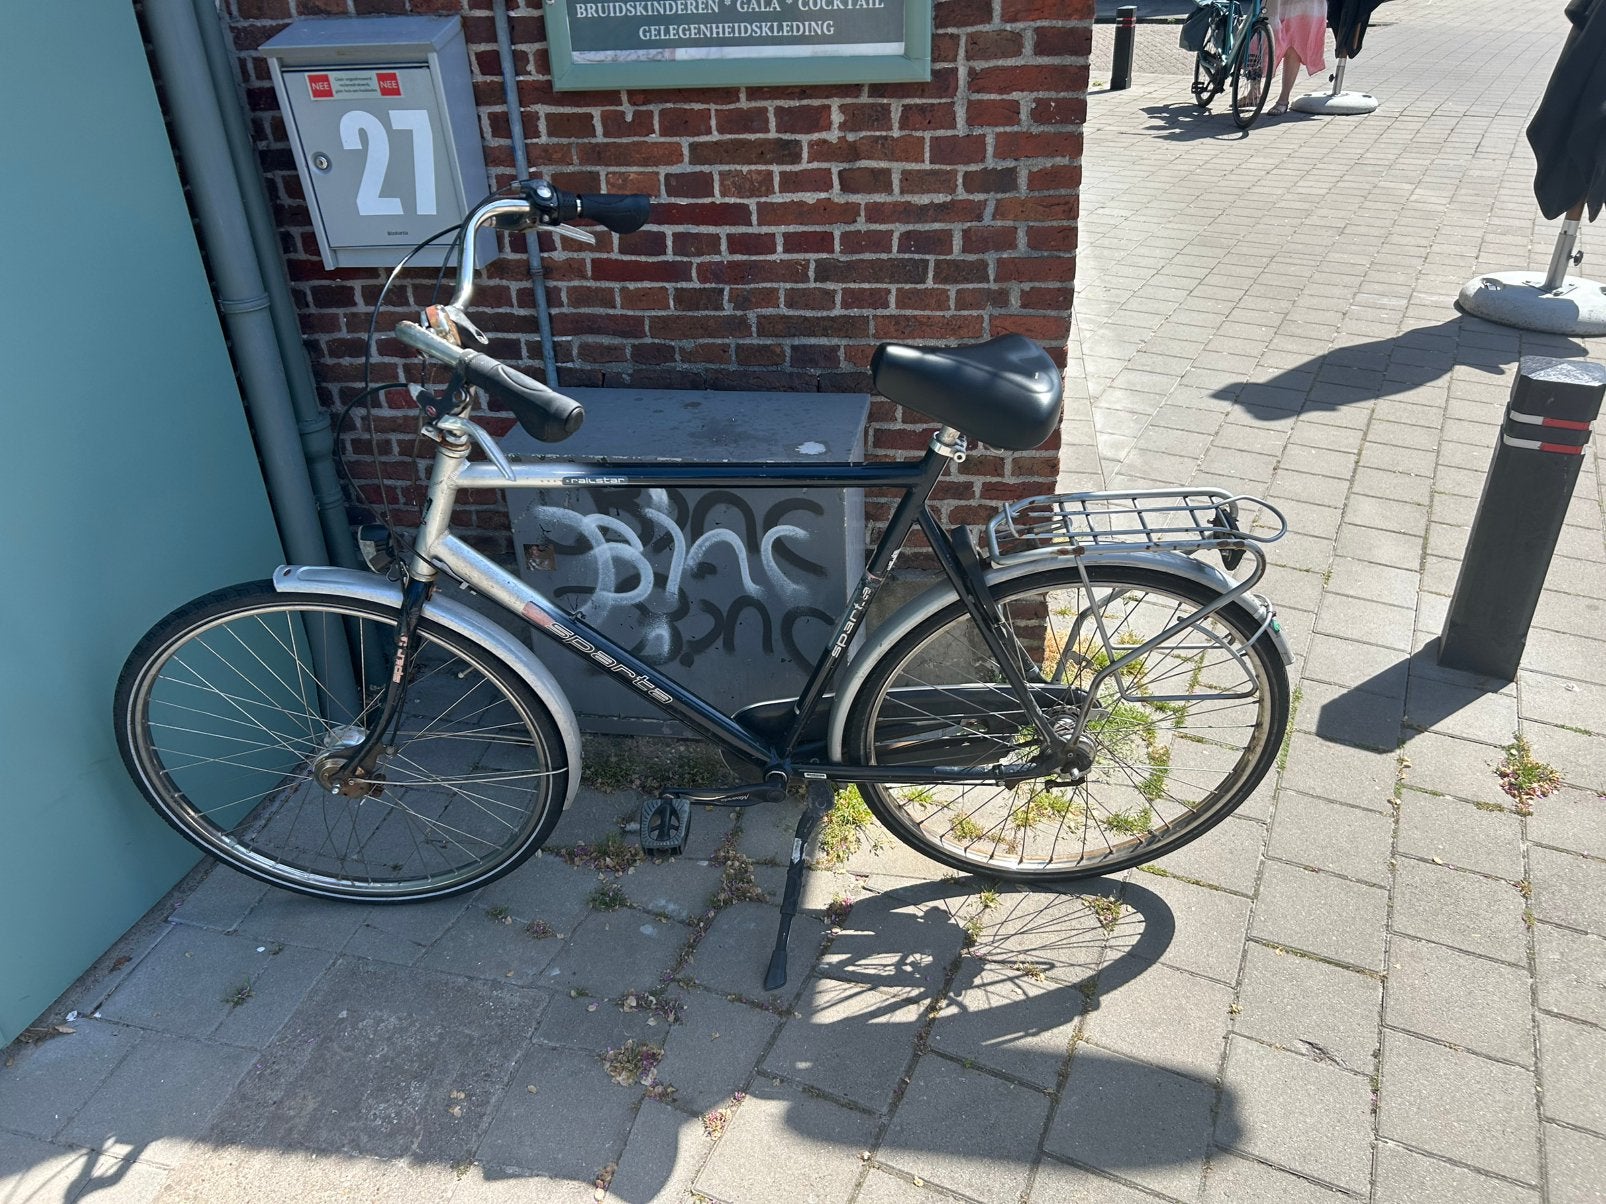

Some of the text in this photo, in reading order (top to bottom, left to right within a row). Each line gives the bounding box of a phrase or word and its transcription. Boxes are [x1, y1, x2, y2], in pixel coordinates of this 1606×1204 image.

[576, 0, 885, 18] BRUIDSKINDEREN GALA COCKTAIL
[638, 20, 835, 40] GELEGENHEIDSKLEDING
[311, 81, 330, 91] NEE
[379, 80, 398, 89] NEE
[340, 109, 437, 216] 27
